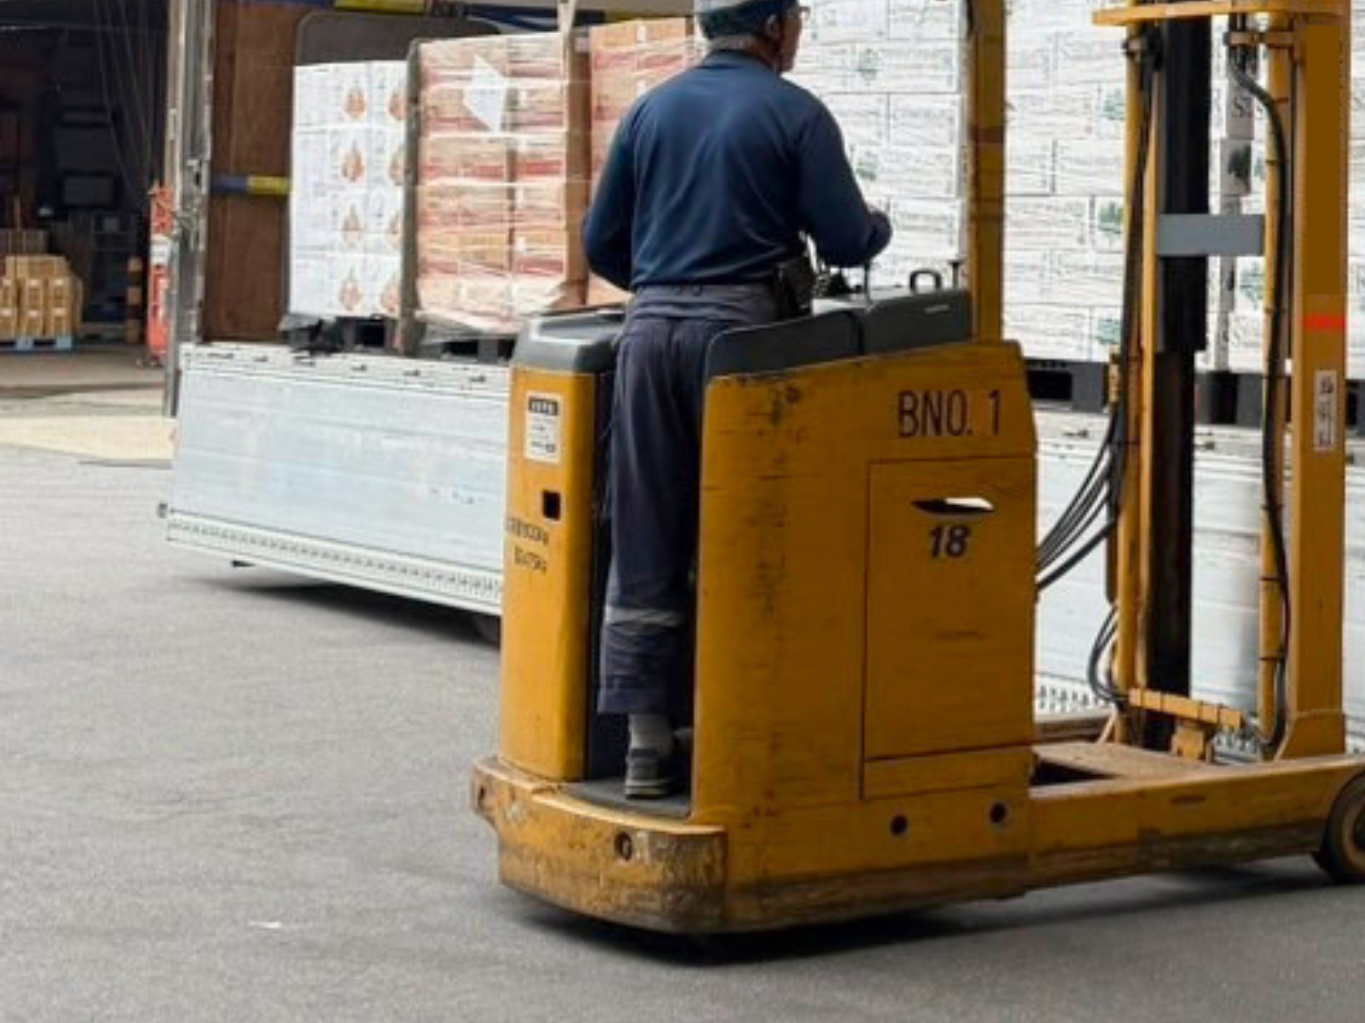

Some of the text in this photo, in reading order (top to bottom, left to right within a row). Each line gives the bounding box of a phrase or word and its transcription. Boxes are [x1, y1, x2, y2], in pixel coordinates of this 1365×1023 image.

[898, 388, 1001, 438] BNO. 1
[930, 525, 971, 559] 18
